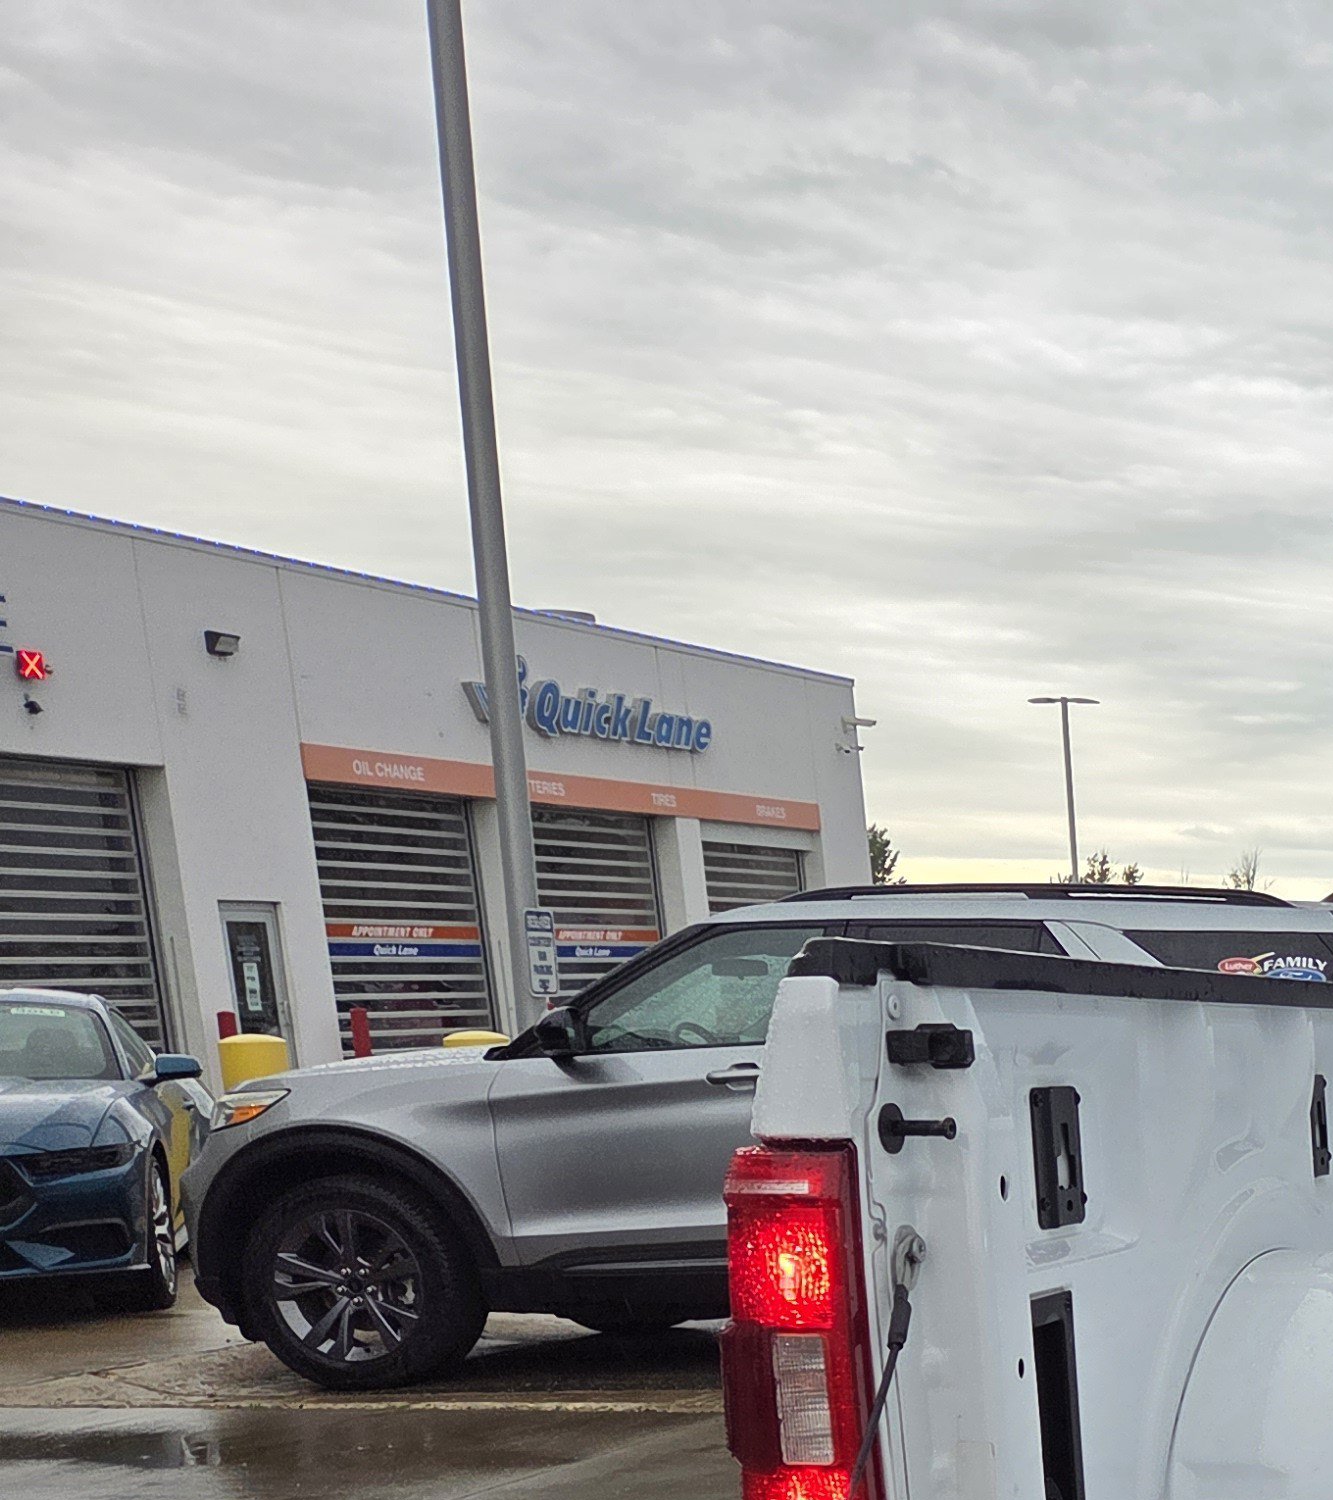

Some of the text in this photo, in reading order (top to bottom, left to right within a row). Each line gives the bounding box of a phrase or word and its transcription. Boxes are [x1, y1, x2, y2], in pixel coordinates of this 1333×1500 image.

[534, 679, 713, 754] Quick Lane
[352, 758, 426, 783] OIL CHANGE
[528, 779, 566, 797] TERIES
[650, 792, 677, 808] TIRES
[755, 804, 787, 820] BRAKES
[351, 925, 434, 938] APPOINTMENT ONLY
[373, 944, 419, 956] Quick Lane
[1263, 956, 1328, 972] FAMILY
